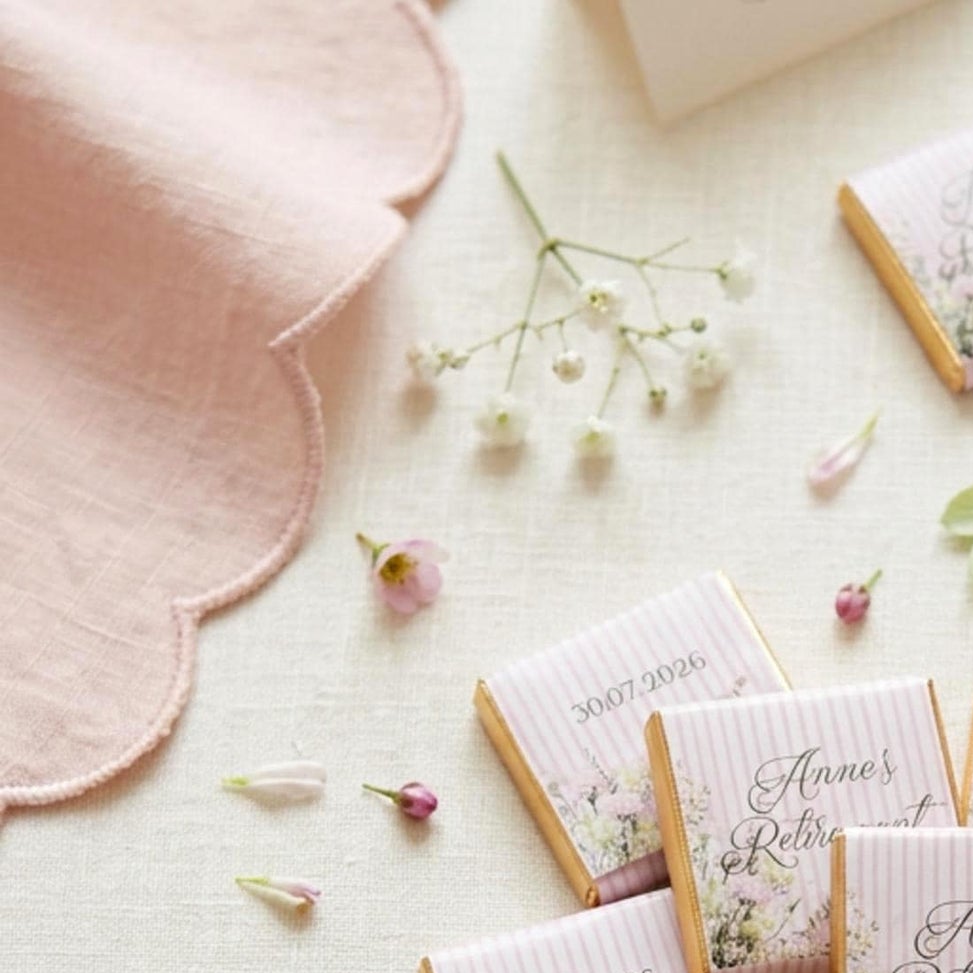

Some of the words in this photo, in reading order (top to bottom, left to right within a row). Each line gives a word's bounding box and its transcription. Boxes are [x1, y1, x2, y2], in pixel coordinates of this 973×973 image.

[571, 650, 707, 726] 30.07.2026
[748, 746, 896, 814] Anne's
[720, 793, 948, 885] Retirt
